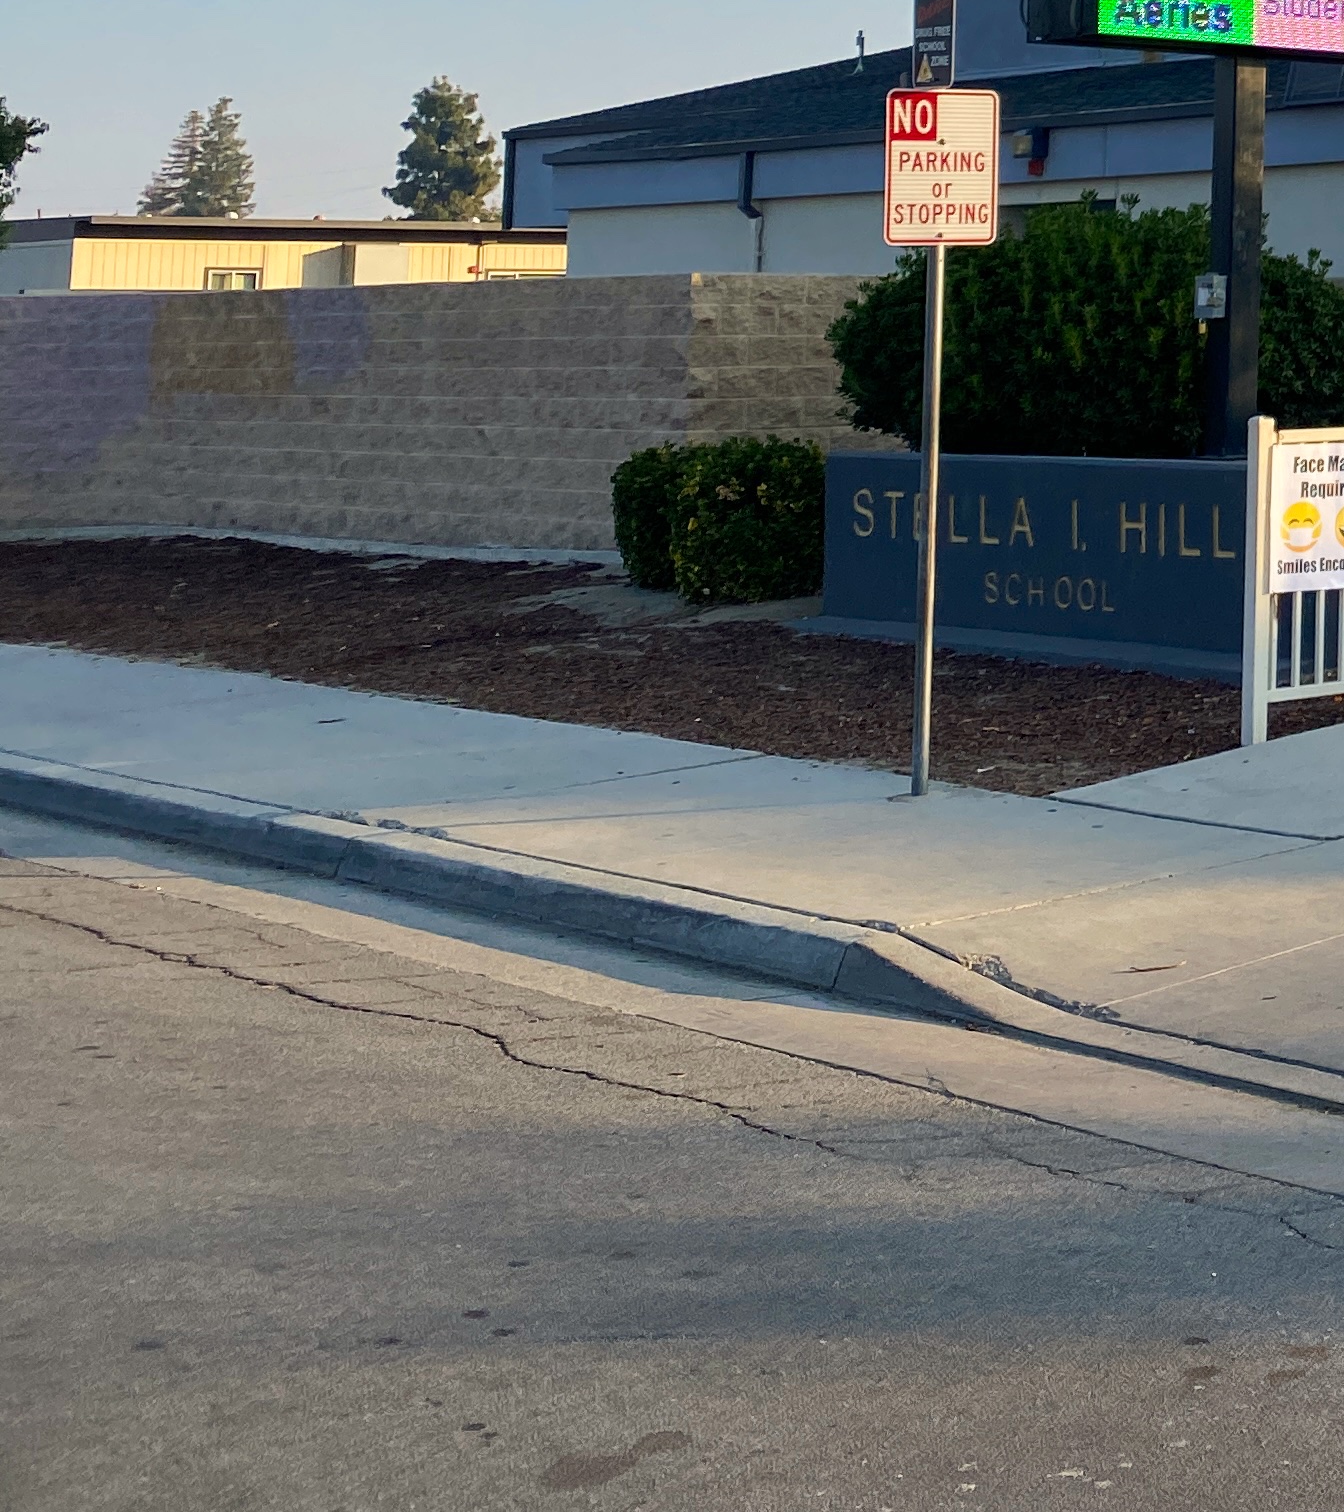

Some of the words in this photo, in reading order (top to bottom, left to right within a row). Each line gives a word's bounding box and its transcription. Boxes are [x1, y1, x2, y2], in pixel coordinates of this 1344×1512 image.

[930, 55, 949, 67] ZONE
[893, 99, 933, 134] NO
[899, 151, 985, 172] PARKING
[932, 182, 952, 199] or
[893, 204, 988, 225] STOPPING
[1293, 456, 1324, 473] Face
[1071, 499, 1087, 552] I.
[1119, 500, 1236, 559] HILL
[1277, 558, 1317, 575] Smiles
[984, 571, 1115, 613] SCHOOL
